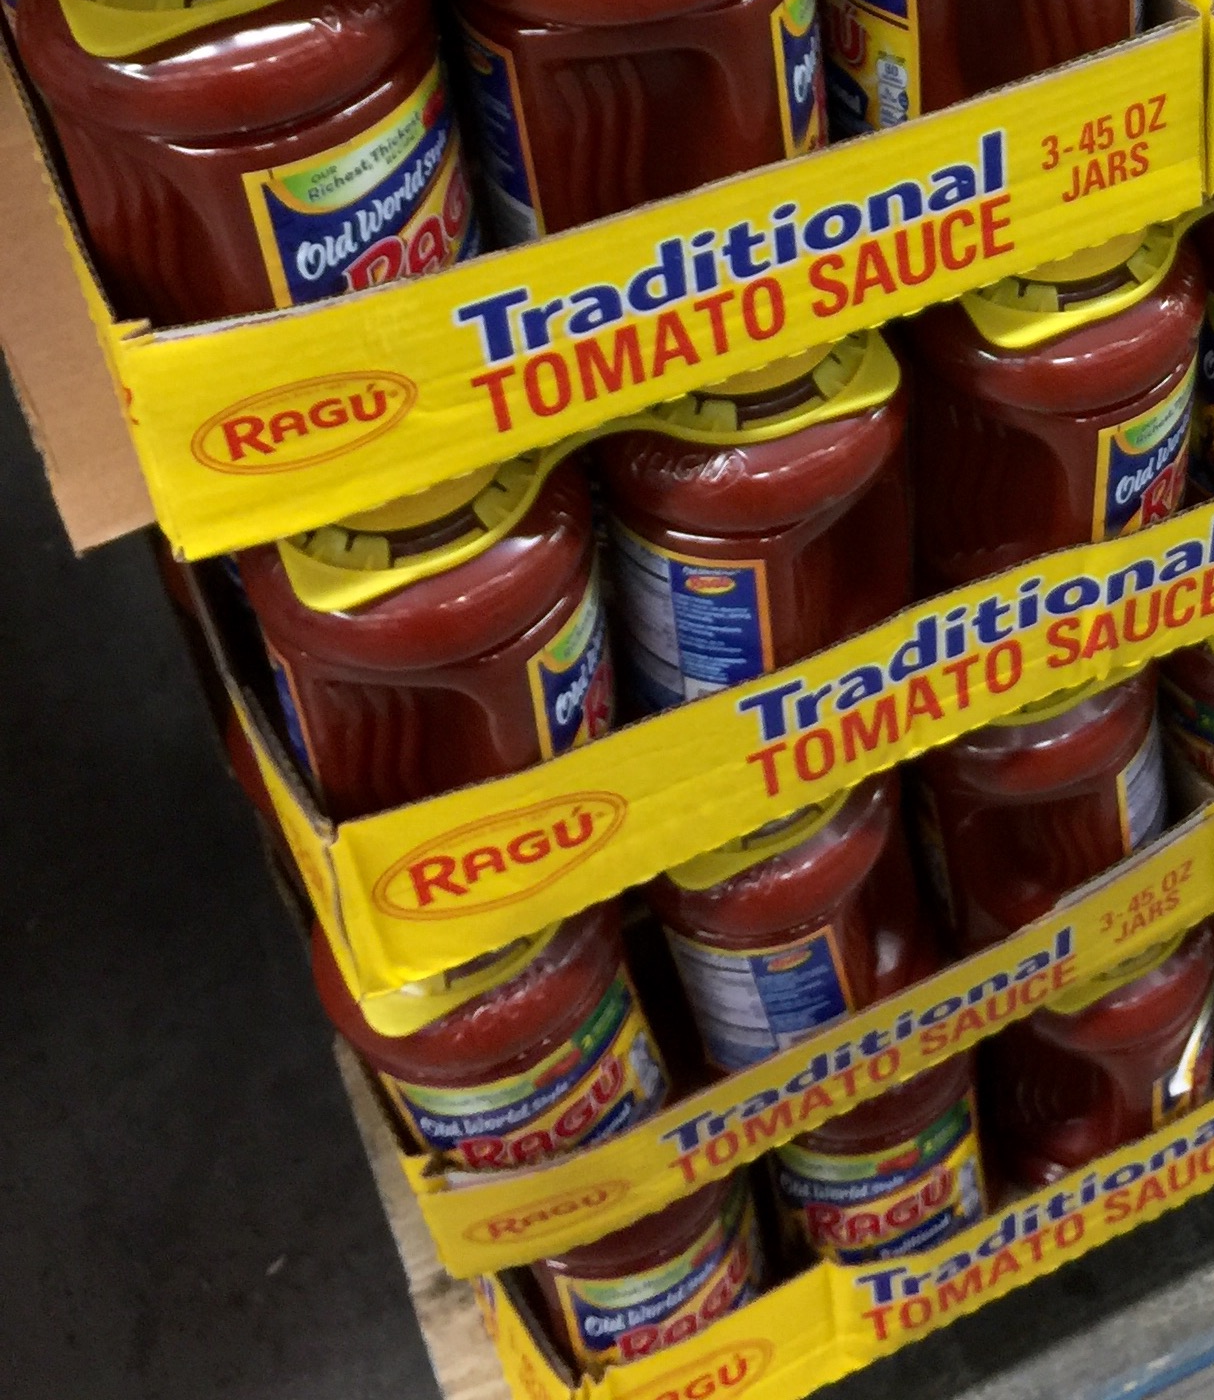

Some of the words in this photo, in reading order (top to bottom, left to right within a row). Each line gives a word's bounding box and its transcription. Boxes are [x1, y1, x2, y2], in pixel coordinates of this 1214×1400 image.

[307, 159, 374, 202] Richest,
[1040, 117, 1115, 171] 3-45
[1124, 94, 1168, 139] OZ
[1062, 142, 1151, 203] JARS
[296, 221, 358, 281] Old
[355, 159, 426, 242] World
[455, 130, 1006, 364] Traditional
[470, 275, 785, 435] TOMATO
[807, 194, 1016, 318] SAUCE
[221, 383, 387, 462] RAGÚ
[1116, 457, 1154, 504] Old
[745, 638, 1024, 796] TOMATO
[407, 811, 595, 908] RAGÚ
[1160, 859, 1193, 894] OZ
[1114, 889, 1182, 944] JARS
[660, 927, 1071, 1151] Traditional
[670, 1050, 901, 1185] TOMATO
[920, 953, 1077, 1056] SAUCE
[862, 1212, 1085, 1341] TOMATO
